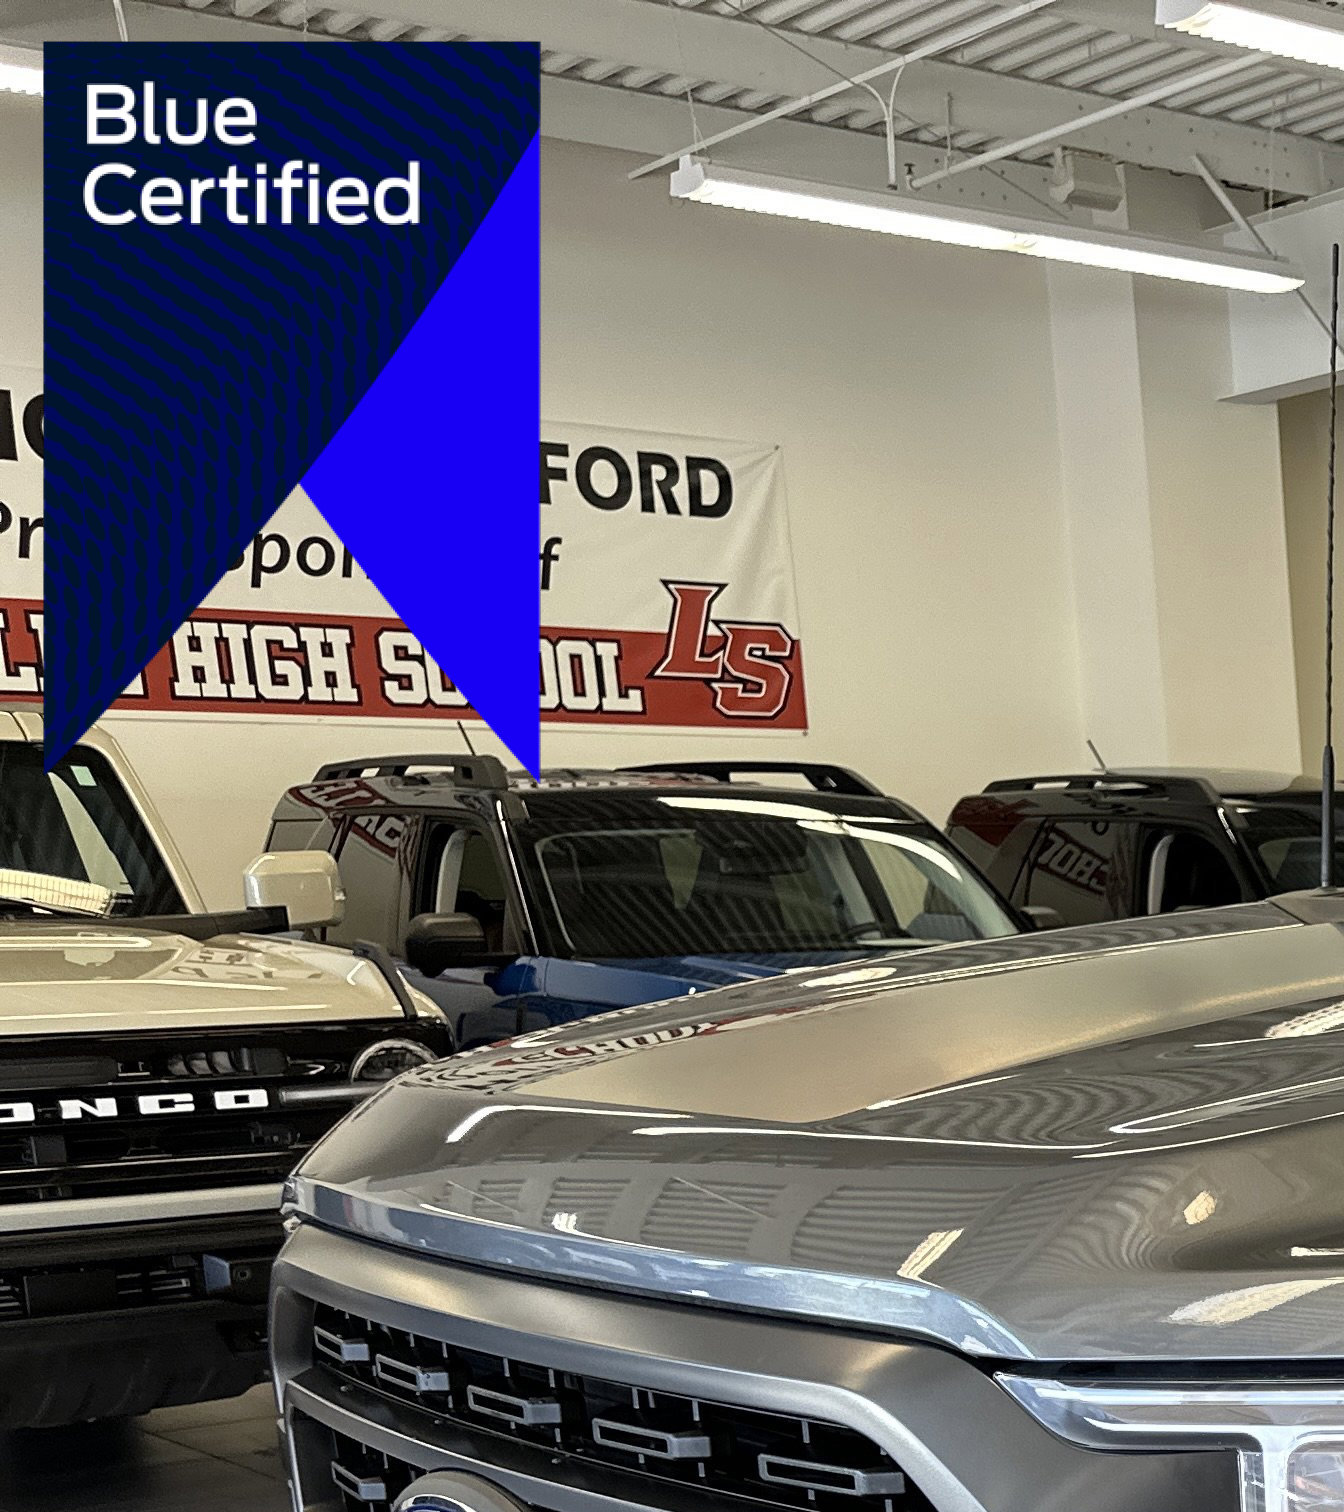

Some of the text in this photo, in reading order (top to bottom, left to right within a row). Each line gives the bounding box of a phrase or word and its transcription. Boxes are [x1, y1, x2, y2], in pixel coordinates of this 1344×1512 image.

[539, 441, 734, 519] FORD
[172, 619, 362, 705] HIGH
[647, 578, 795, 720] LS
